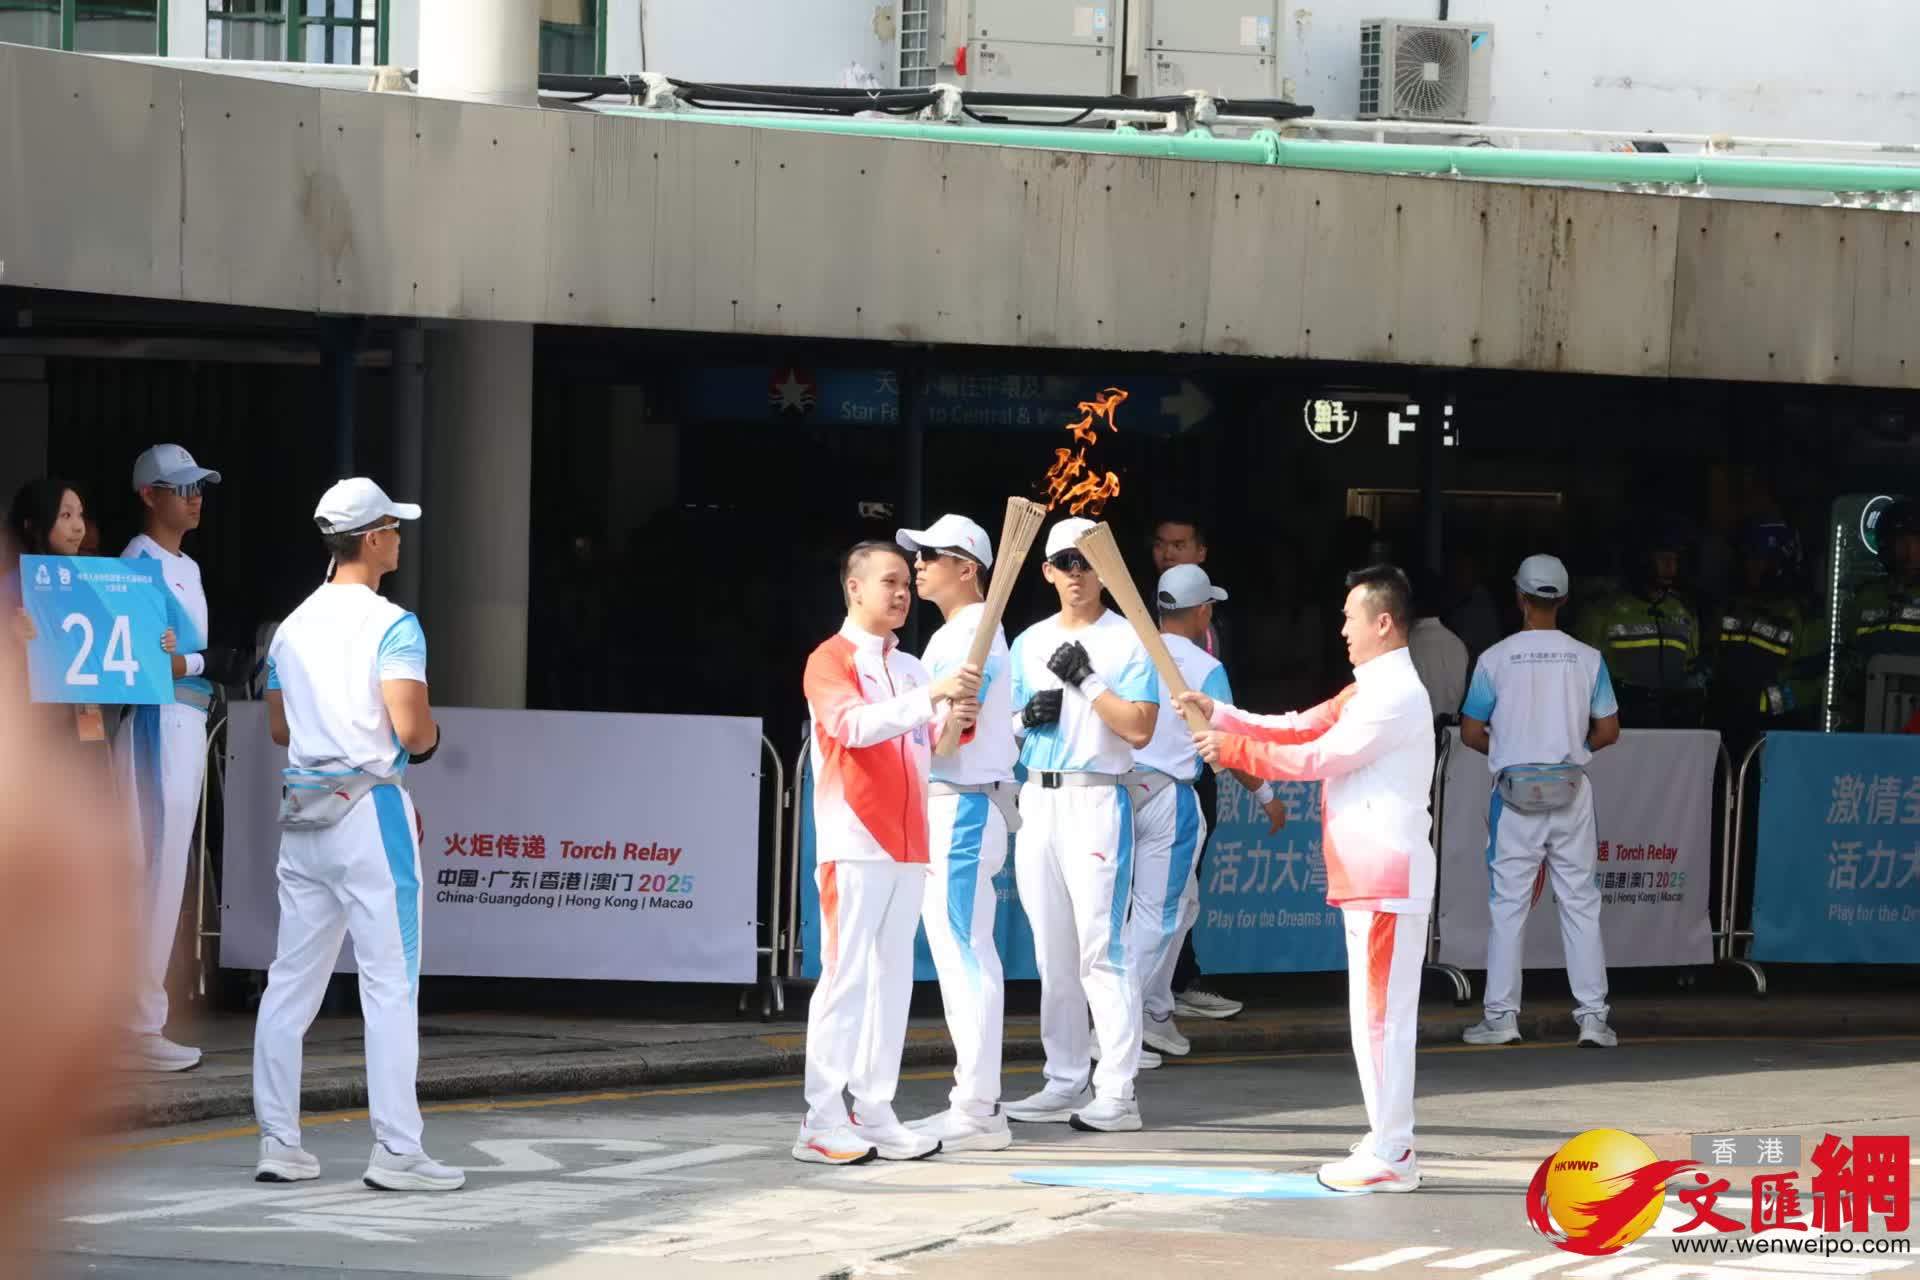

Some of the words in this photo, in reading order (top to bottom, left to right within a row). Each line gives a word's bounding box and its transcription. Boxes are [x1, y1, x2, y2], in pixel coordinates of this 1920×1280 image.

[841, 402, 874, 421] Star
[61, 612, 140, 687] 24
[444, 833, 546, 860] 火炬传递
[560, 840, 617, 860] Torch
[623, 842, 682, 866] Relay
[1616, 844, 1645, 861] Torch
[1647, 843, 1679, 865] Relay
[637, 873, 694, 895] 2025
[1655, 871, 1687, 889] 2025
[565, 894, 601, 910] Hong
[604, 896, 639, 911] Kong
[649, 896, 694, 911] Macao
[1207, 909, 1234, 934] Play
[1236, 909, 1257, 928] for
[1278, 909, 1321, 928] Dreams
[1324, 911, 1337, 927] in
[1828, 904, 1854, 926] Play
[1879, 904, 1898, 921] the
